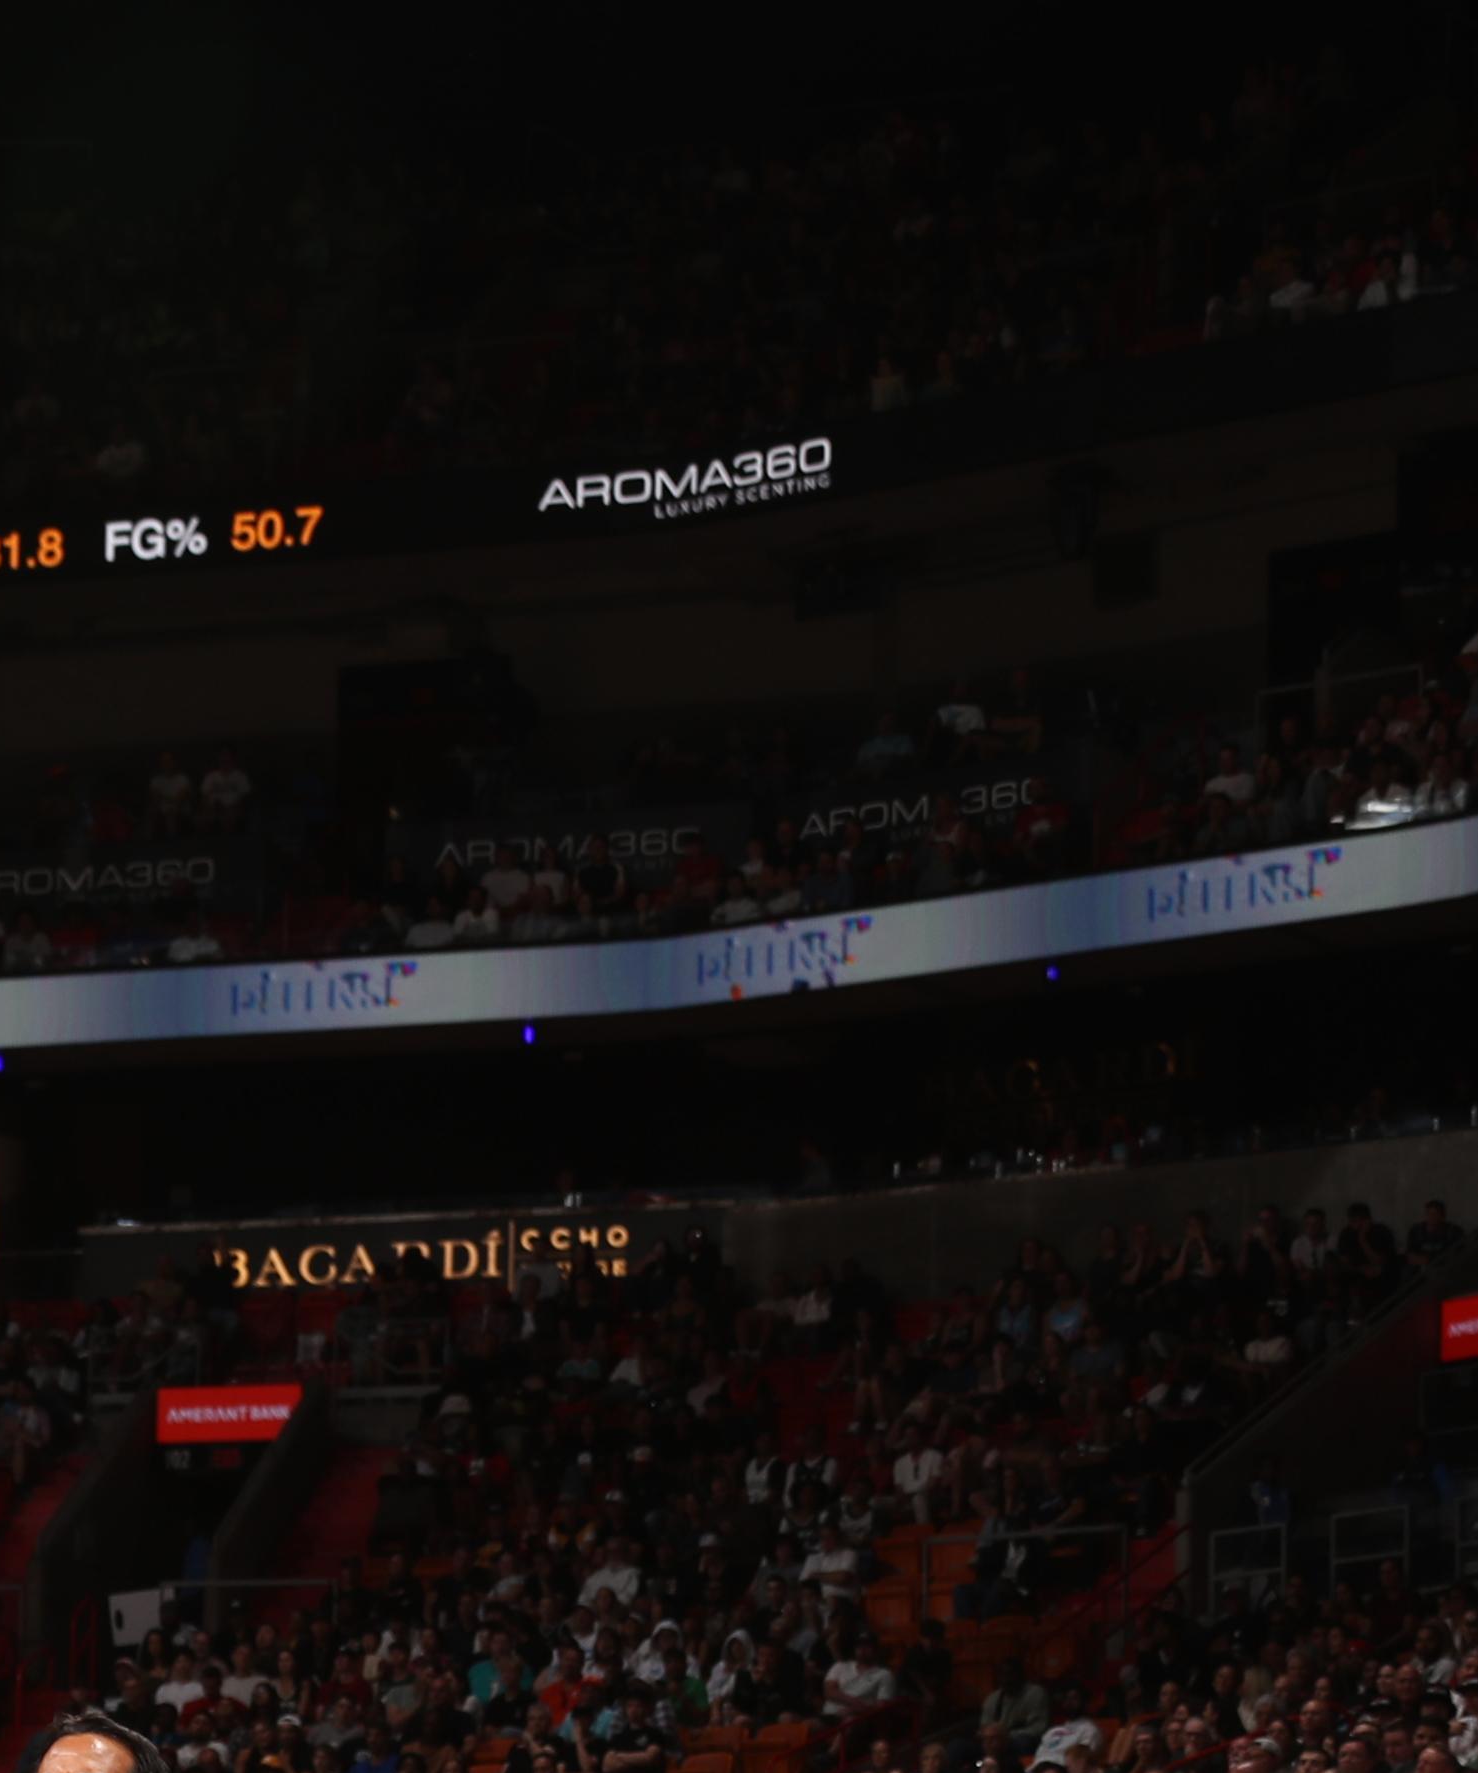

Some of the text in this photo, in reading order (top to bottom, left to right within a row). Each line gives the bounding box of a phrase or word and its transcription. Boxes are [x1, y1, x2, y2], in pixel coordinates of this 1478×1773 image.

[538, 437, 833, 512] AROMA360
[653, 473, 833, 520] LUXURY SCENTING
[104, 505, 324, 562] FG% 50.7
